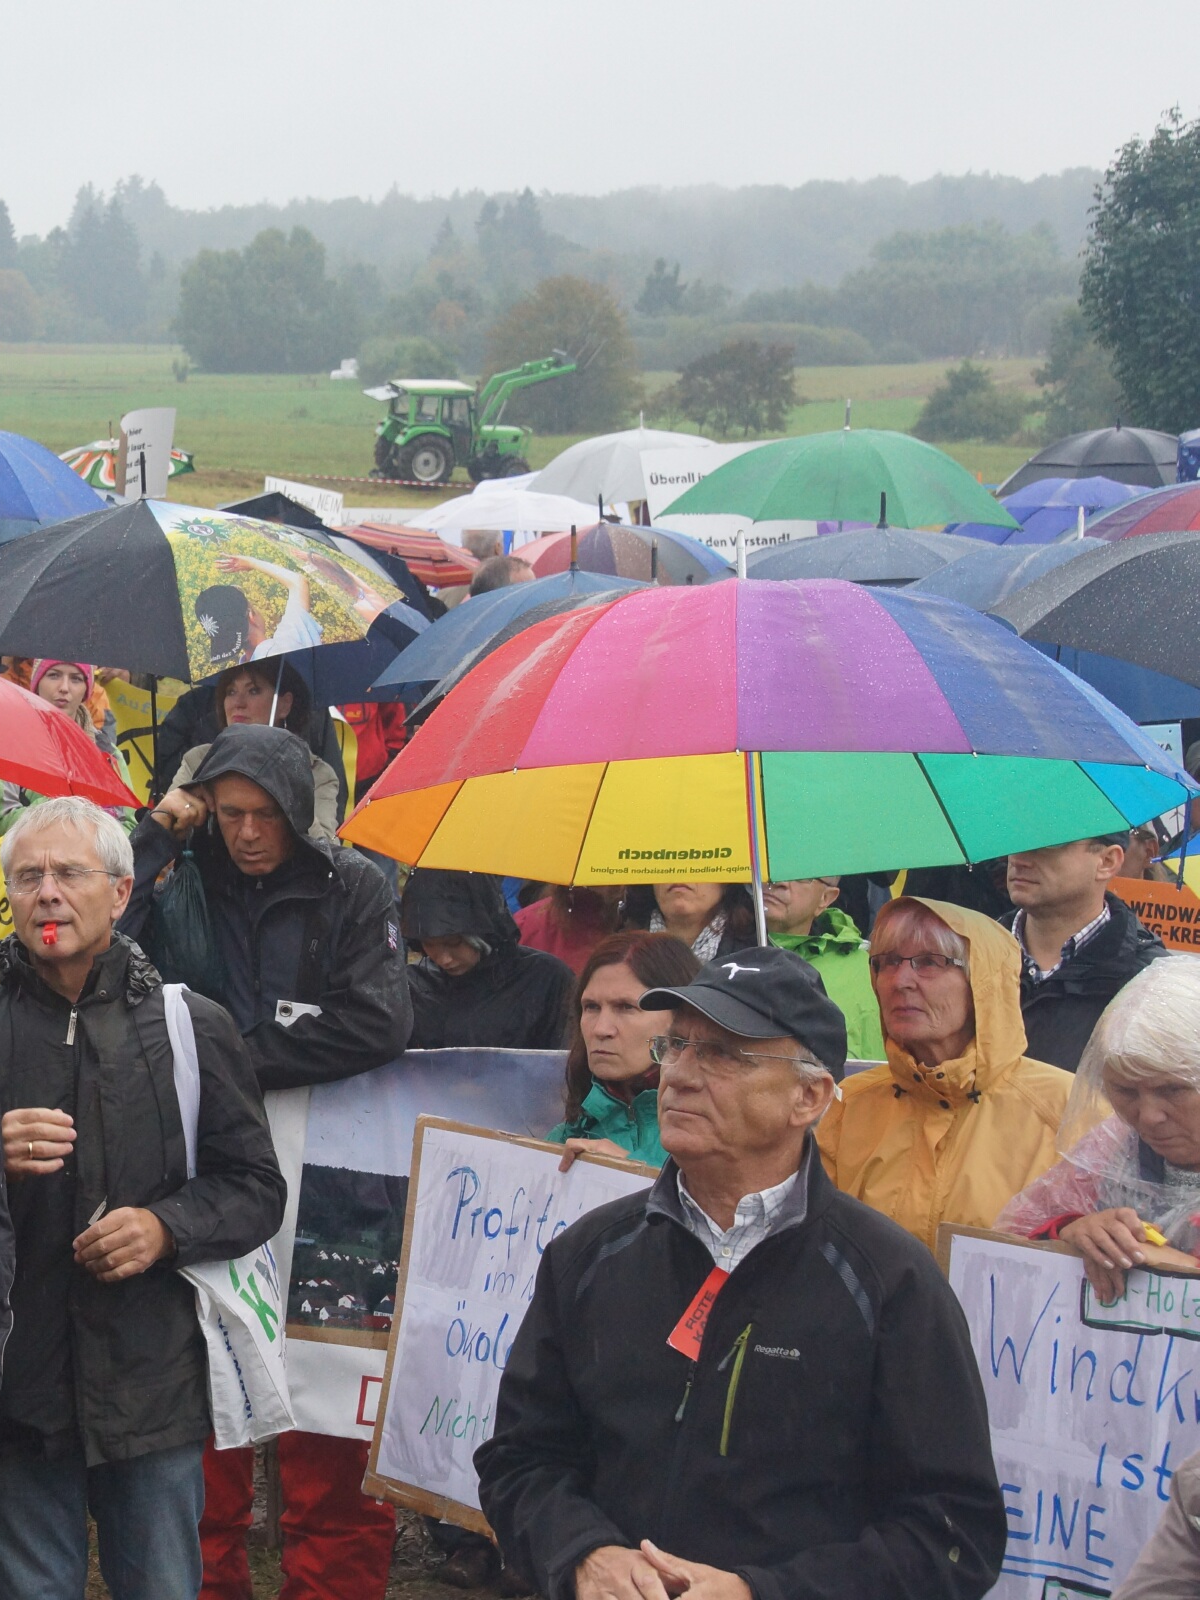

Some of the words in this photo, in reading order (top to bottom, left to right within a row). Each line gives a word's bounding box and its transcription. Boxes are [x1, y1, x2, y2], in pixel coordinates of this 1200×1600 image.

[650, 472, 695, 485] Überall
[317, 493, 342, 513] NEIN
[706, 533, 727, 547] den
[730, 533, 791, 547] Vrstand!
[483, 1255, 515, 1293] im
[753, 1343, 790, 1356] Regatta
[1096, 1421, 1173, 1502] ist
